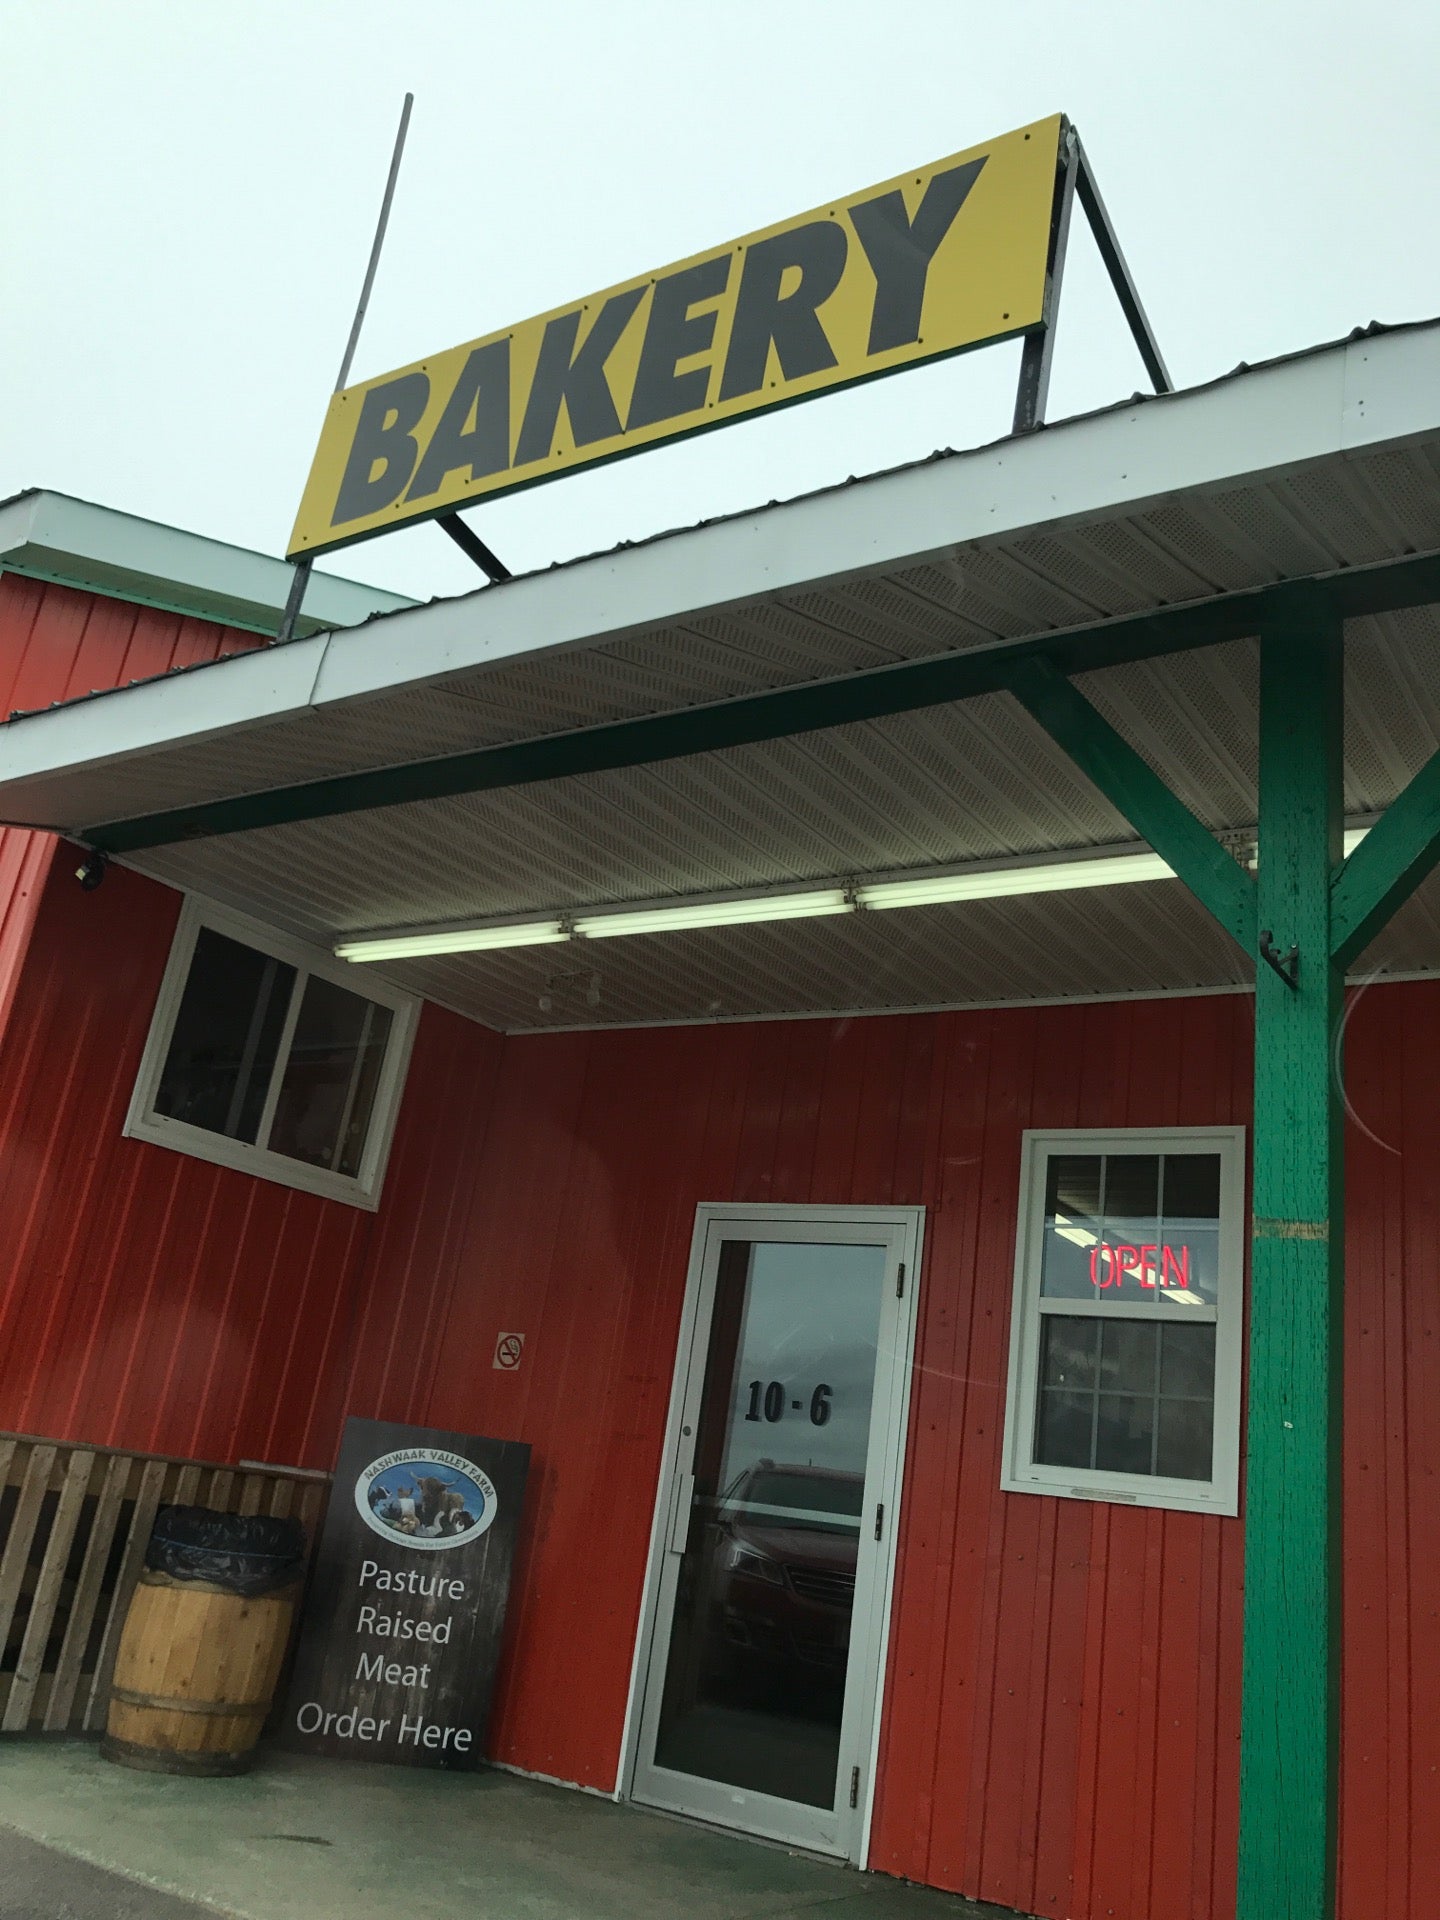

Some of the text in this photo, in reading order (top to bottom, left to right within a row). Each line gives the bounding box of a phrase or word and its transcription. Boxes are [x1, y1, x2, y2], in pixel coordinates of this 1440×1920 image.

[329, 154, 990, 527] BAKERY
[1089, 1244, 1190, 1289] OPEN
[364, 1449, 494, 1498] NASHWAAK VALLEY FARM
[359, 1560, 465, 1600] Pasture
[356, 1606, 452, 1644] Raised
[355, 1652, 431, 1689] Meat
[296, 1702, 472, 1751] Order Here
